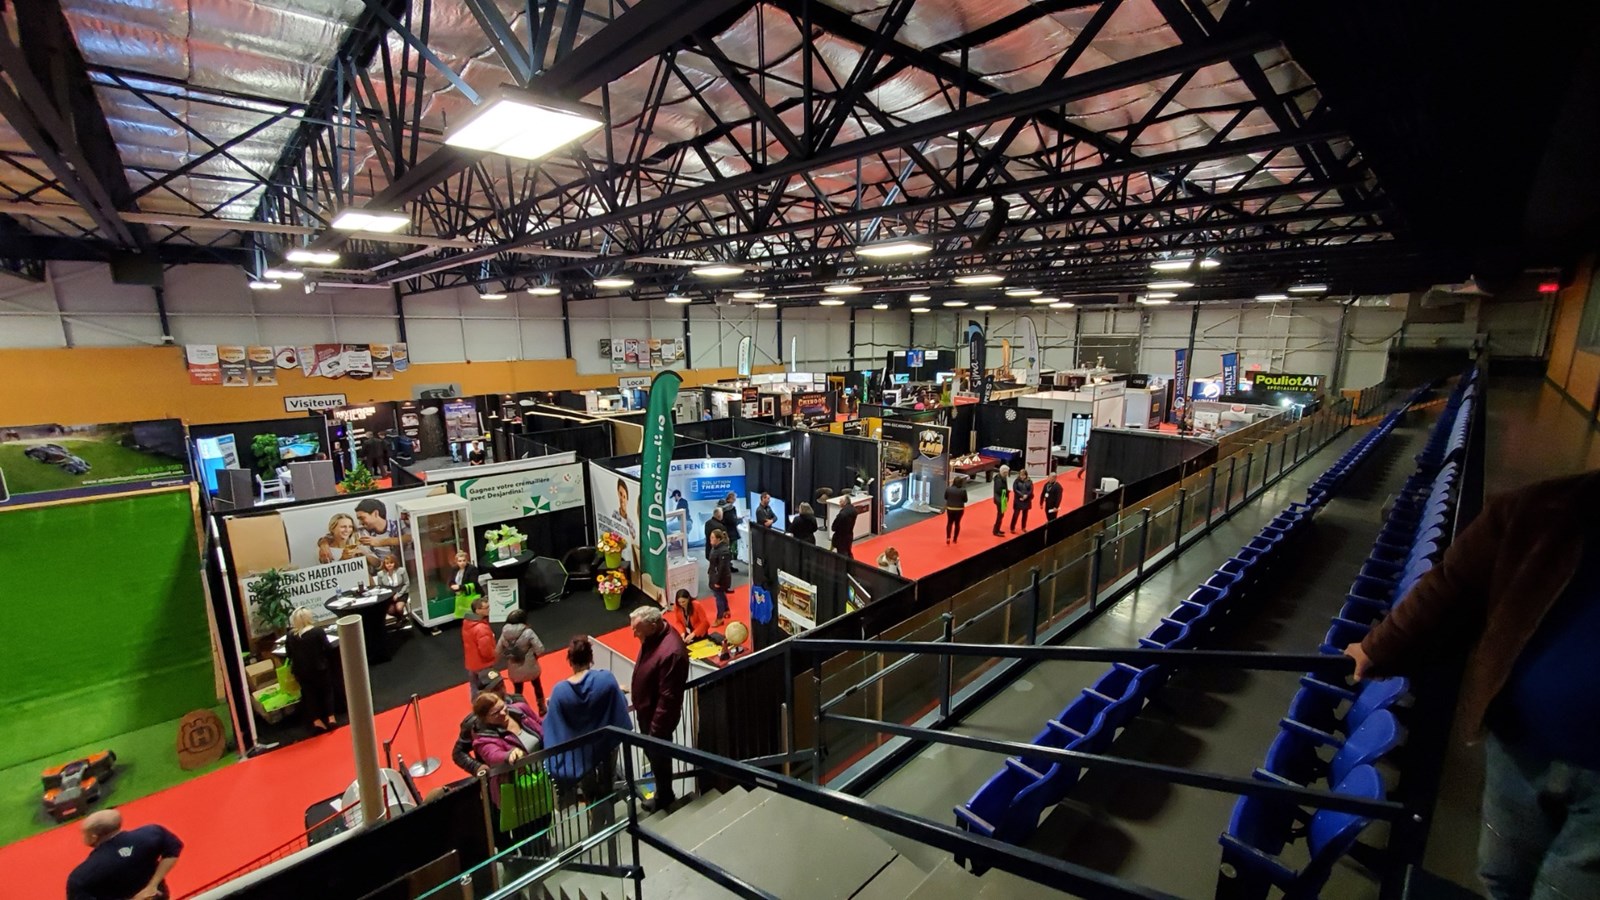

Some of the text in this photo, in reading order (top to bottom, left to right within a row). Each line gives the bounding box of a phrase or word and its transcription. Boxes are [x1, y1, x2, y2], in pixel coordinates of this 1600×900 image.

[290, 399, 343, 409] Visiteurs
[469, 486, 495, 494] Gagnez
[515, 477, 550, 487] crémaillère
[487, 487, 524, 499] Desjardins!
[308, 560, 364, 581] HABITATION
